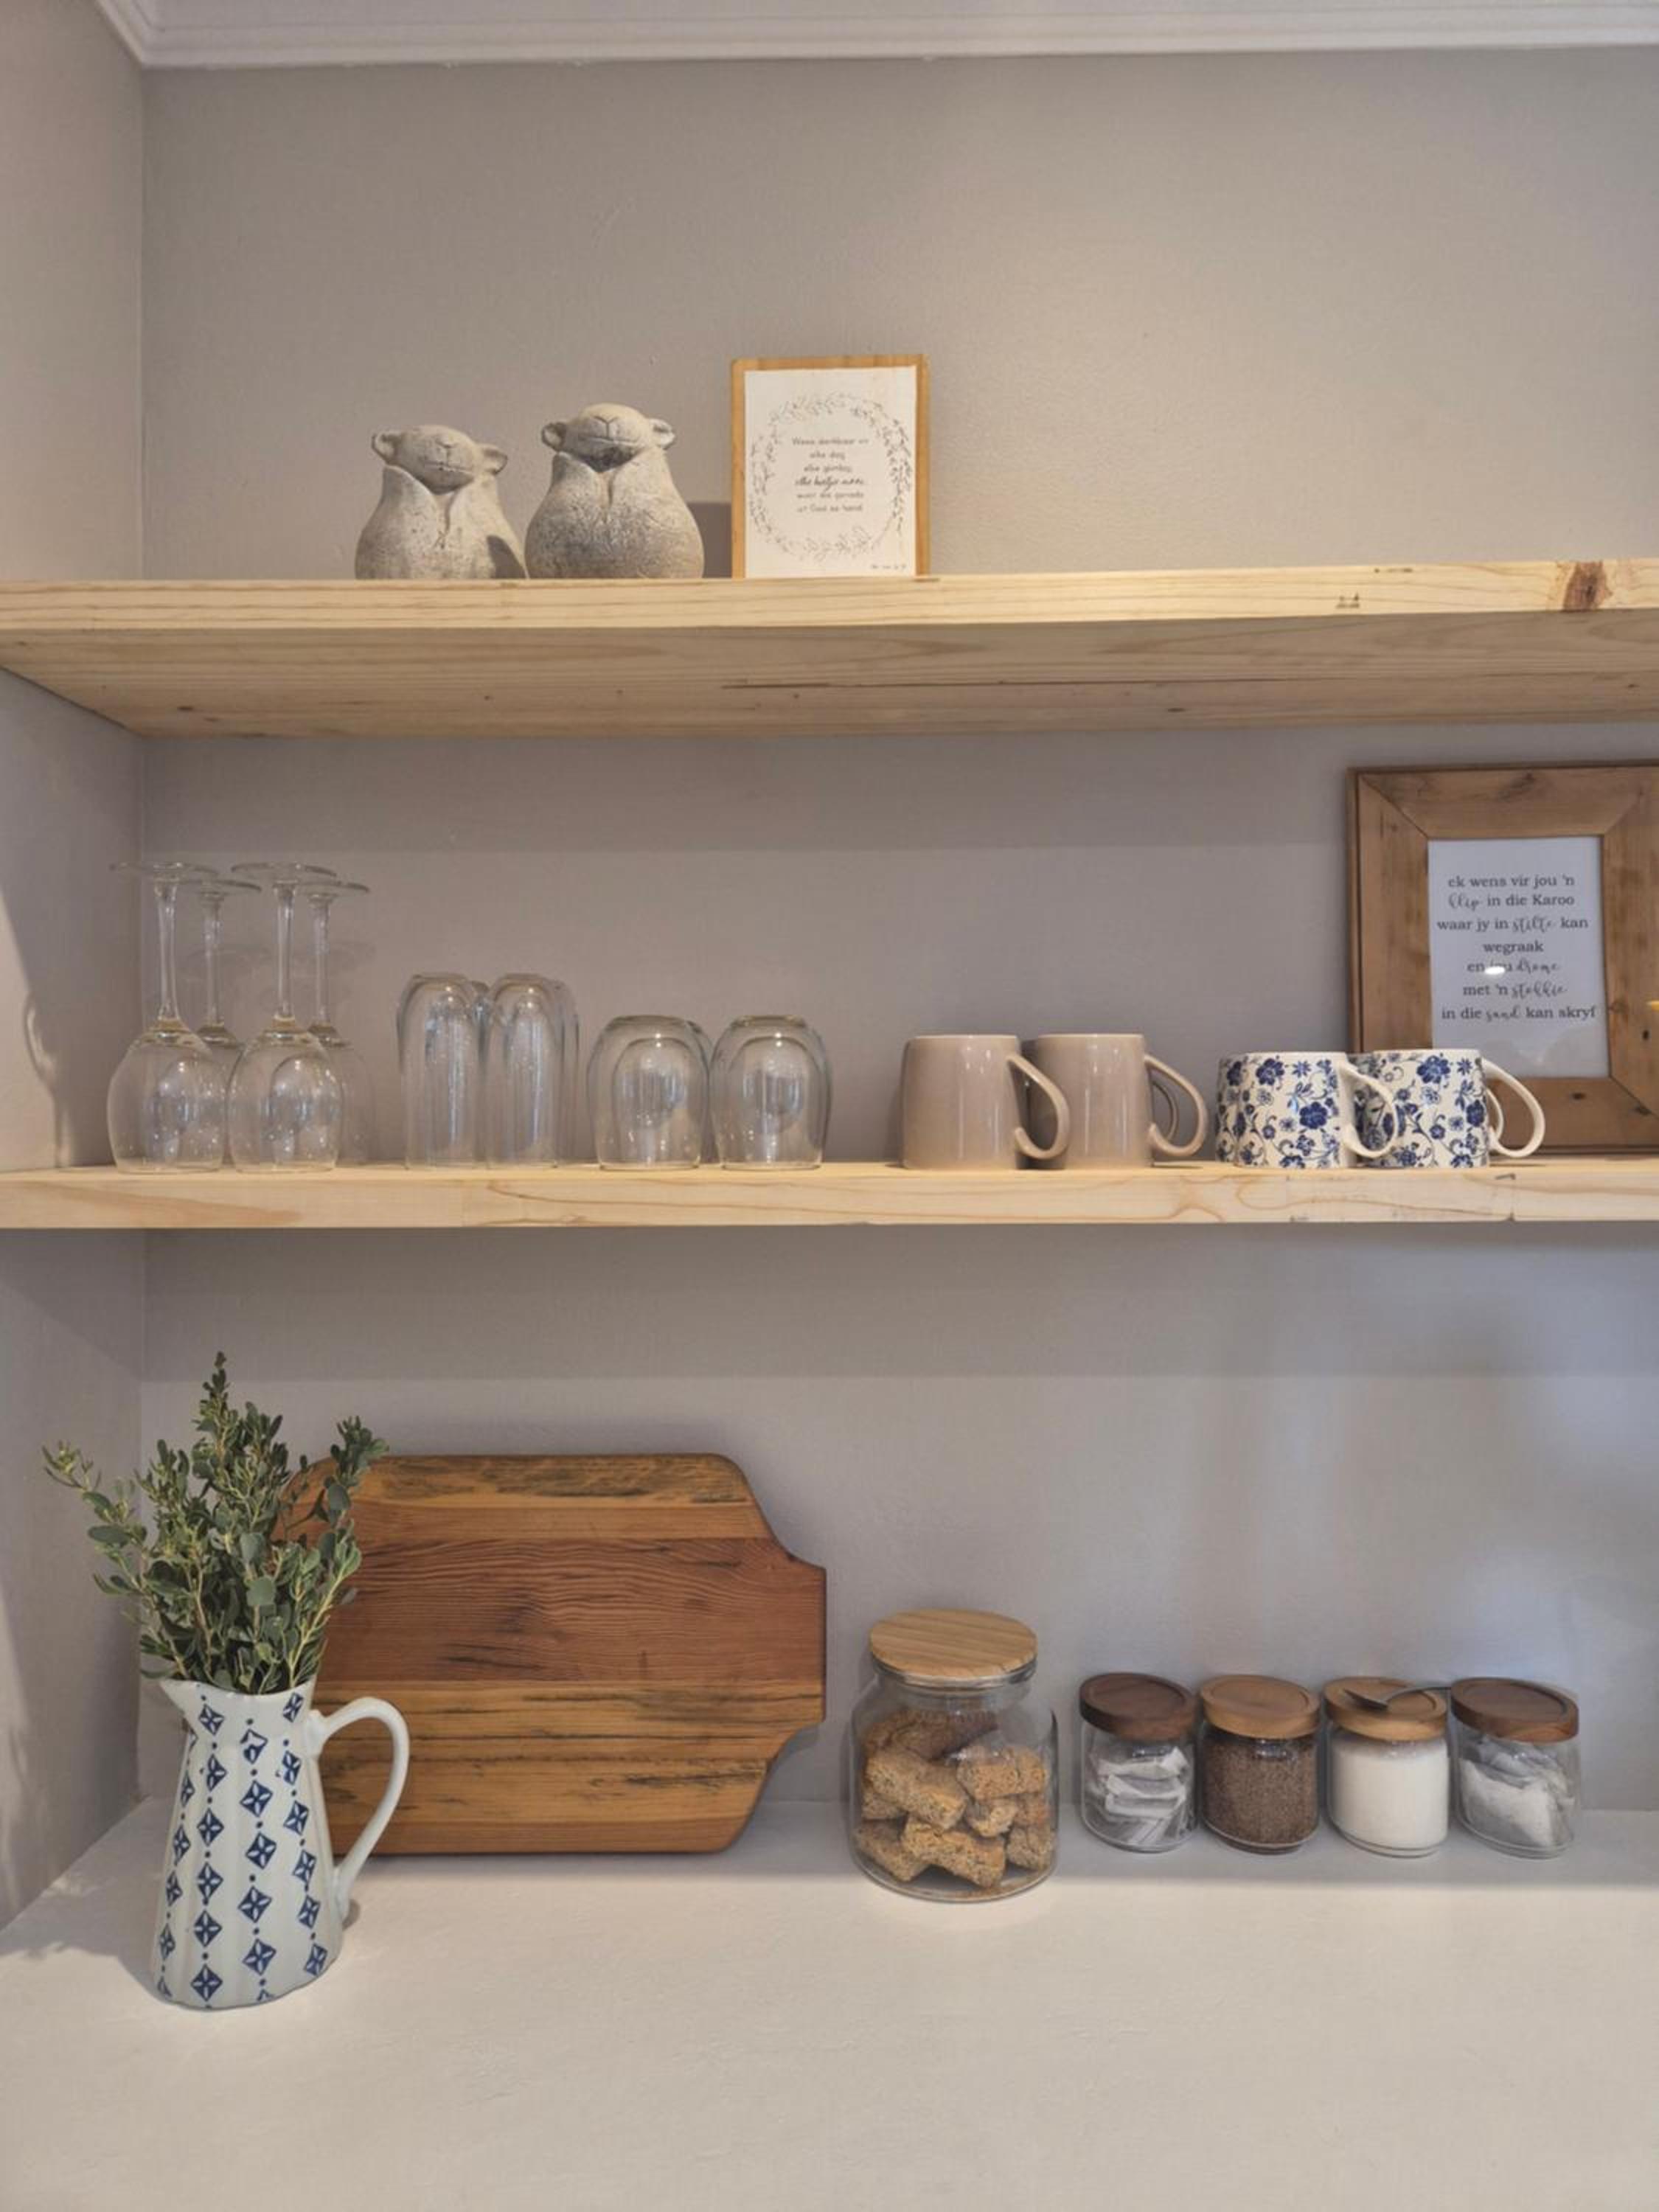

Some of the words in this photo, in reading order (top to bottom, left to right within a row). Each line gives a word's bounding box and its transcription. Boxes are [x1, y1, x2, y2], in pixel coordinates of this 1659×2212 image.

[1448, 875, 1465, 888] ek
[1469, 876, 1507, 887] wens
[1510, 875, 1529, 886] vir
[1532, 874, 1557, 889] jou
[1487, 894, 1500, 906] in
[1506, 894, 1527, 905] die
[1532, 894, 1575, 905] Karoo
[1437, 919, 1472, 931] waar
[1475, 919, 1490, 933] jy
[1495, 917, 1509, 929] in
[1560, 917, 1589, 929] kan
[1483, 940, 1544, 956] wegraak
[1467, 961, 1484, 973] en
[1463, 984, 1490, 995] met
[1441, 1007, 1455, 1020] in
[1460, 1006, 1482, 1019] die
[1486, 1004, 1522, 1022] sand
[1526, 1006, 1554, 1019] kan
[1558, 1005, 1596, 1020] skryf
